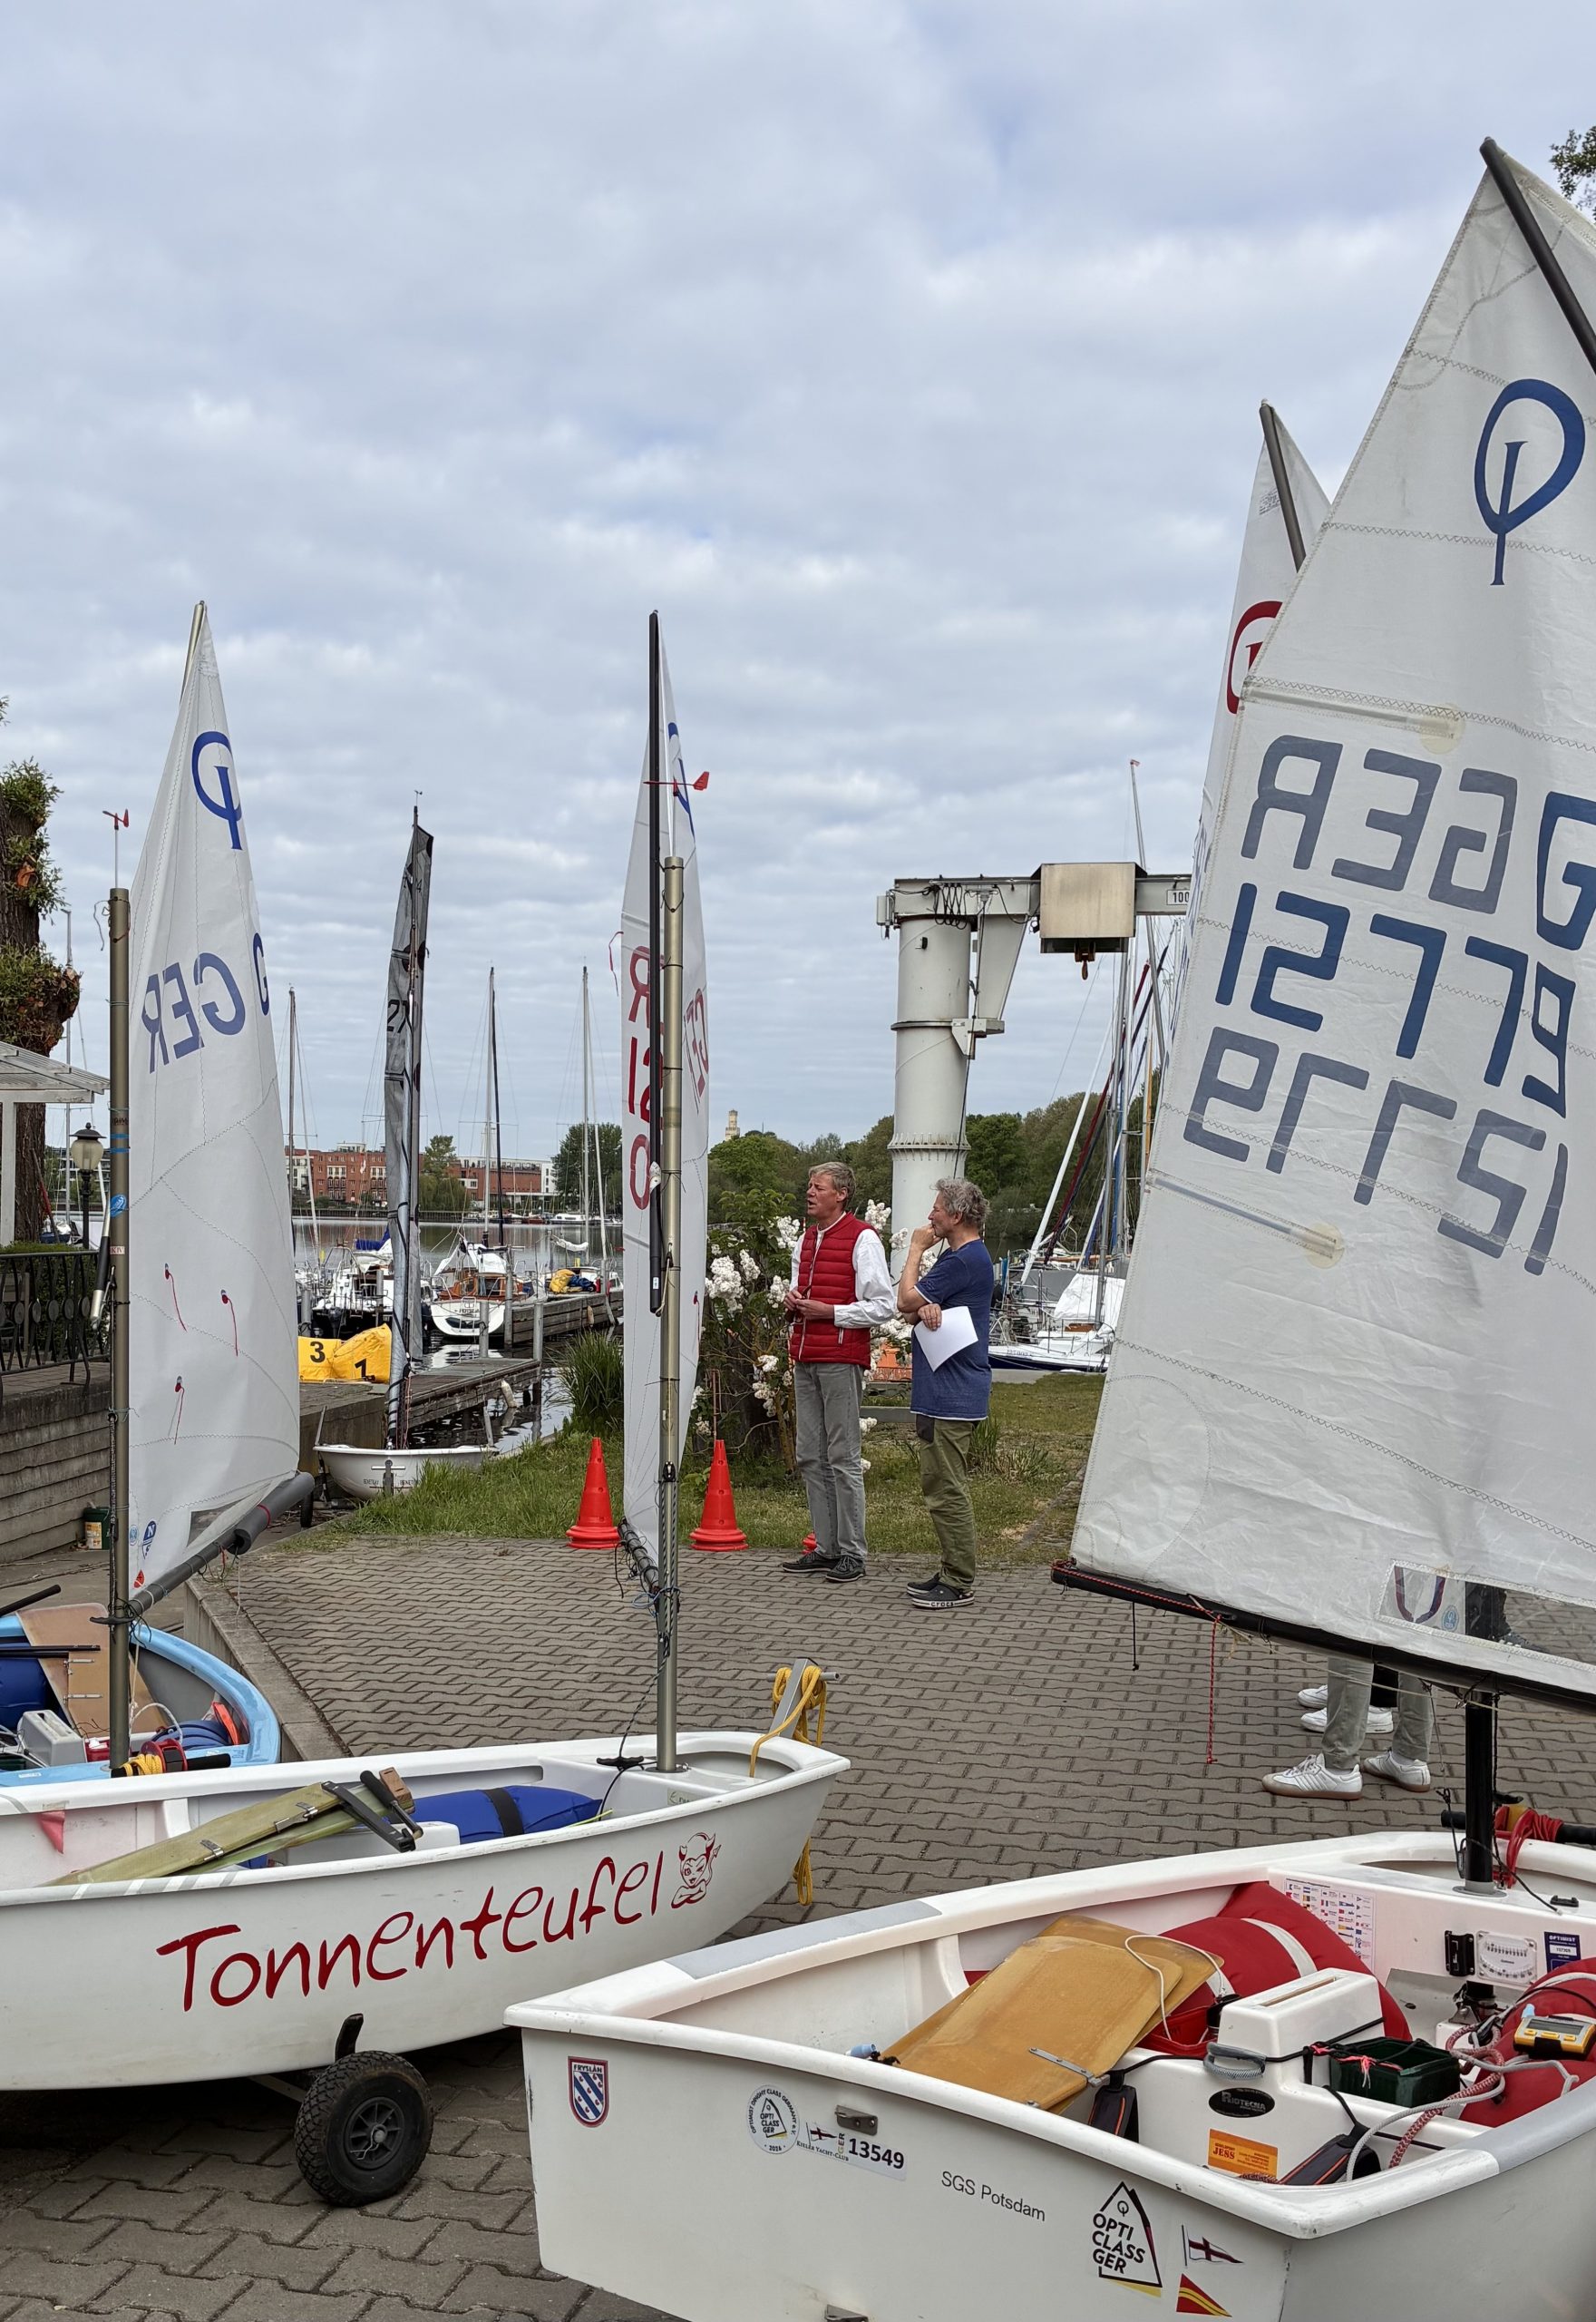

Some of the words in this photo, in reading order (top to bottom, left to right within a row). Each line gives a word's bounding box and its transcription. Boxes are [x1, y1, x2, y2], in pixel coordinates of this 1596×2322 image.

[1215, 882, 1576, 1118] 12779
[309, 1341, 326, 1363] 3
[157, 1850, 664, 2013] Tonnenteufel
[766, 2088, 782, 2098] CLASS
[837, 2132, 845, 2154] GER
[848, 2138, 905, 2170] 13549
[1212, 2146, 1236, 2160] JESS
[940, 2170, 977, 2196] SGS
[980, 2183, 1046, 2222] Potsdam
[1092, 2211, 1134, 2241] OPTI
[1091, 2229, 1146, 2264] CLASS
[1091, 2248, 1127, 2275] GER
